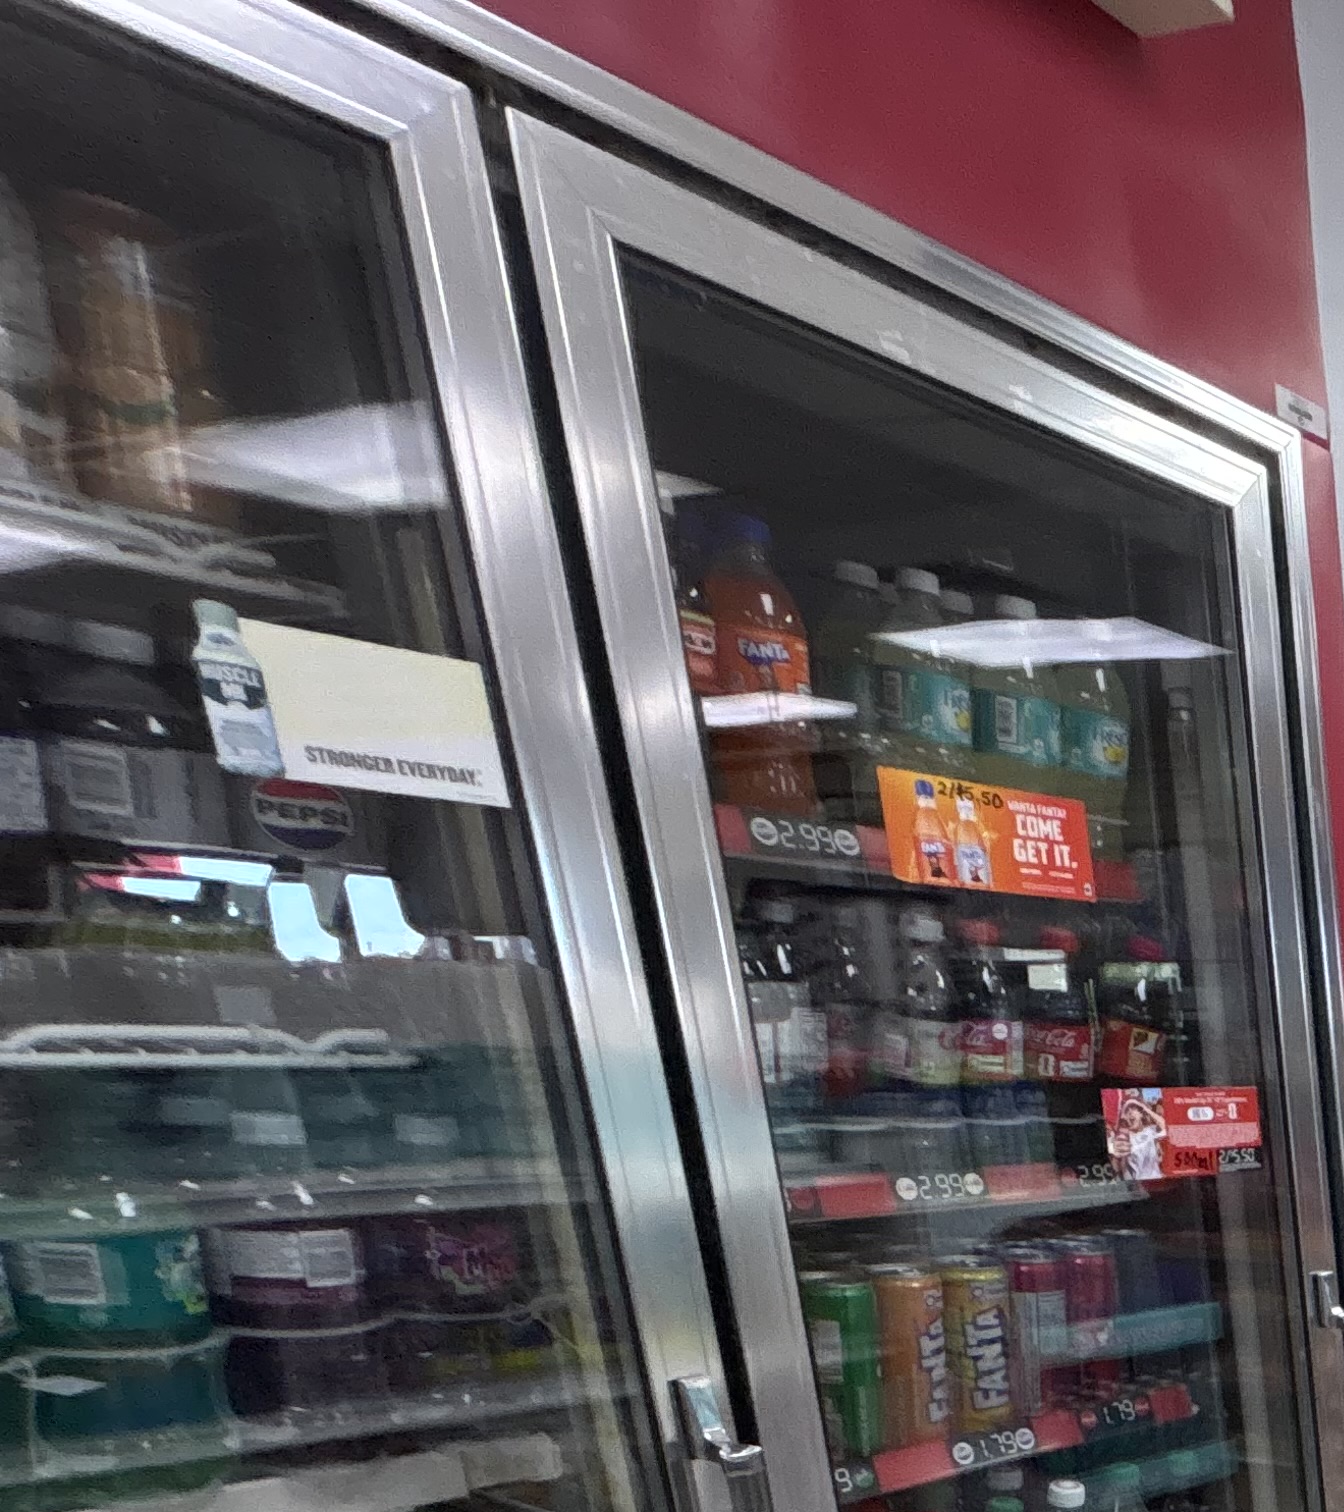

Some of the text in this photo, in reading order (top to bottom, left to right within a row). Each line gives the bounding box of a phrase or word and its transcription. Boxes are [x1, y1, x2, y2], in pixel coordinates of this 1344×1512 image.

[304, 745, 395, 774] STRONGER
[256, 799, 349, 827] PEPSI
[1015, 814, 1063, 841] COME
[777, 819, 836, 854] 2.99
[1012, 838, 1079, 869] GET IT.
[917, 1172, 965, 1200] 2.99
[964, 1307, 1012, 1410] FANTA
